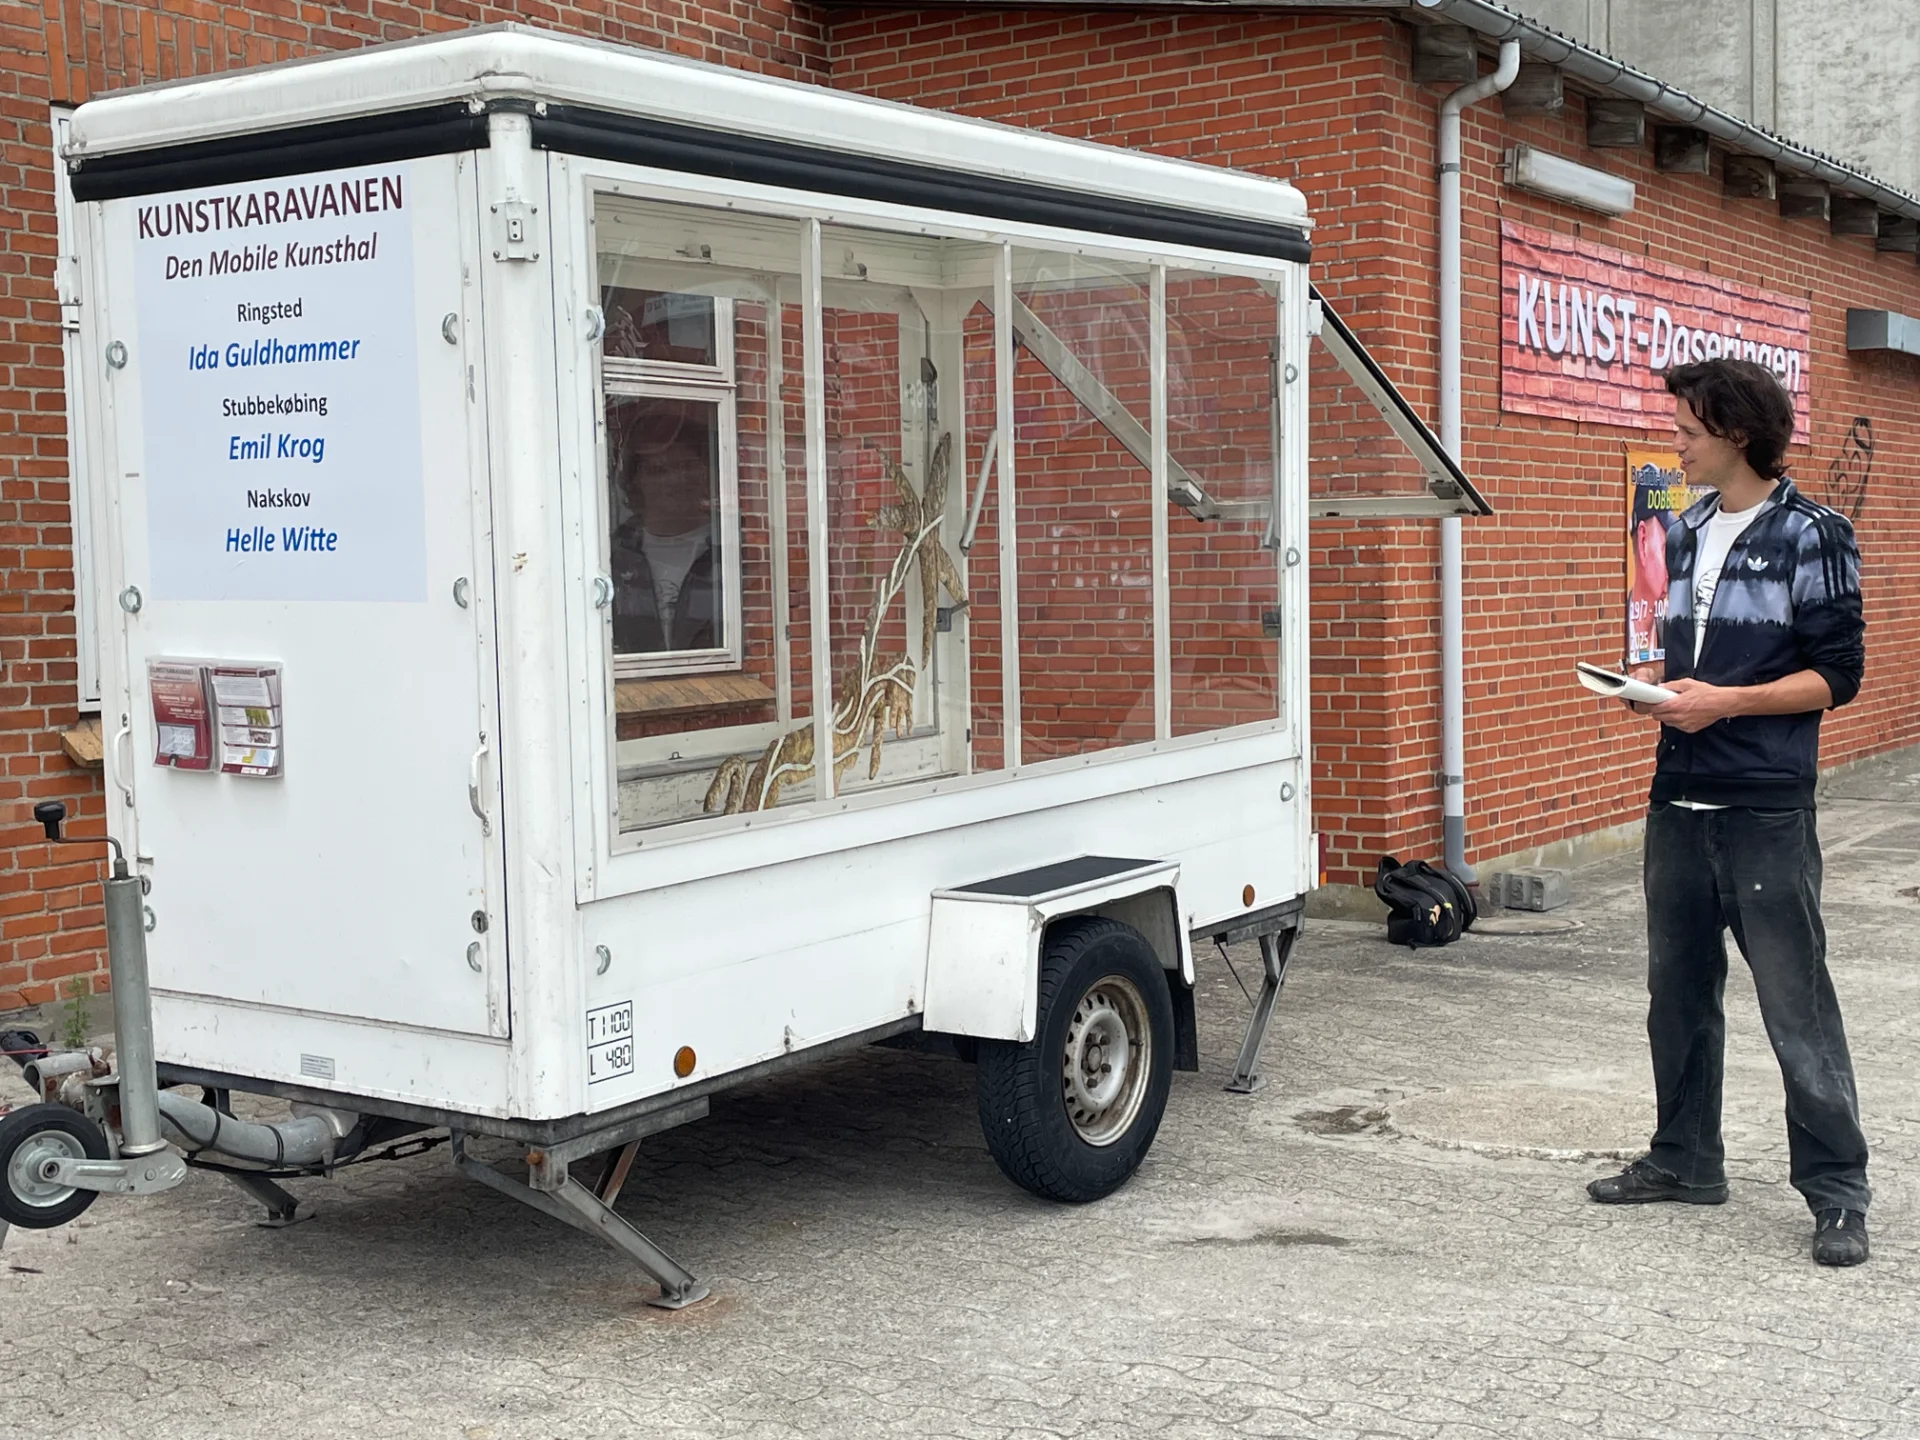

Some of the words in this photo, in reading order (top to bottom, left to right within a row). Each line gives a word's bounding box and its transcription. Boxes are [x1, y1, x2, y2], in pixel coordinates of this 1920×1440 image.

[138, 174, 403, 240] KUNSTKARAVANEN
[165, 255, 203, 280] Den
[209, 243, 279, 276] Mobile
[285, 231, 378, 268] Kunsthal
[237, 297, 303, 325] Ringsted
[189, 343, 219, 371] Ida
[225, 337, 361, 369] Guldhammer
[222, 392, 328, 417] Stubbekøbing
[229, 432, 272, 460] Emil
[277, 433, 325, 464] Krog
[247, 487, 311, 509] Nakskov
[226, 526, 276, 552] Helle
[282, 525, 338, 552] Witte
[1654, 599, 1668, 621] 10/
[588, 1017, 597, 1040] T
[602, 1009, 630, 1037] 1100
[590, 1053, 597, 1076] L
[605, 1044, 631, 1069] 480
